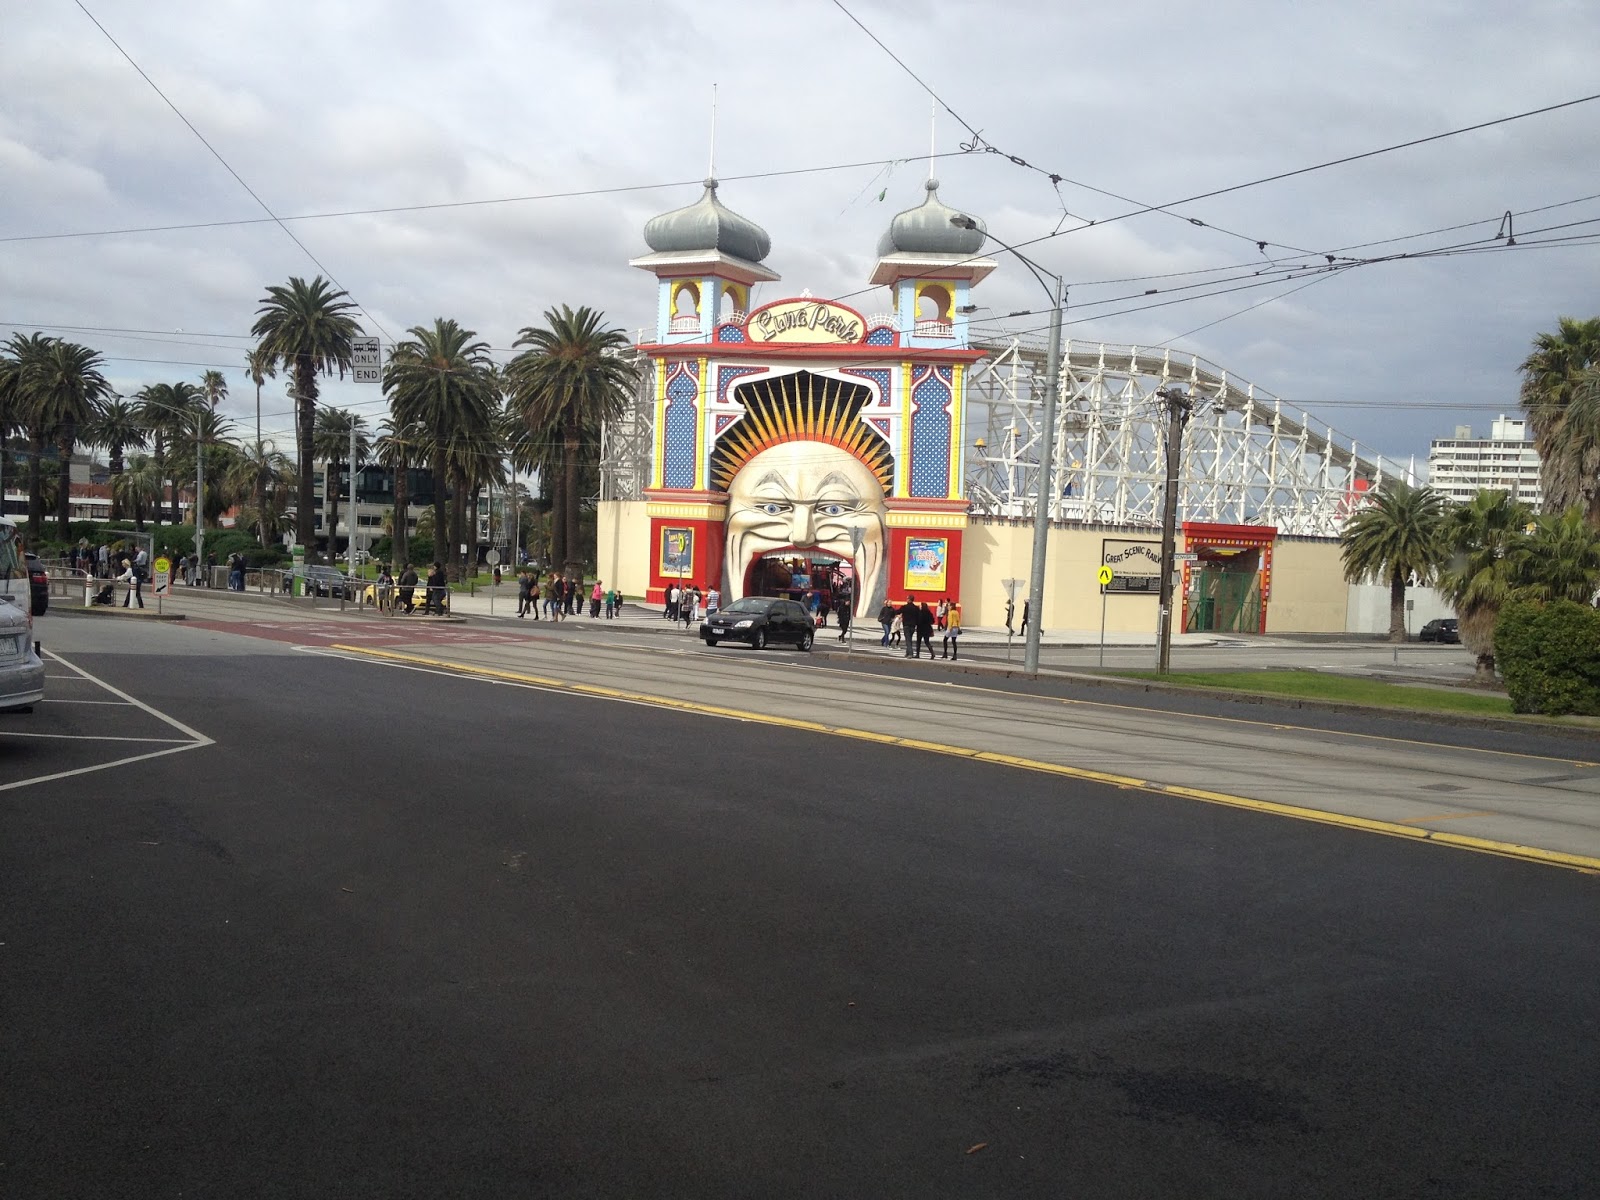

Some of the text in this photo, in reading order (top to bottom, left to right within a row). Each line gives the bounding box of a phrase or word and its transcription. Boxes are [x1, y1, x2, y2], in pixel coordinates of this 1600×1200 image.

[757, 303, 858, 343] Luna Park
[354, 355, 378, 363] ONLY
[356, 371, 378, 379] END
[1105, 553, 1123, 563] GREAT
[1124, 546, 1145, 559] SCENIC
